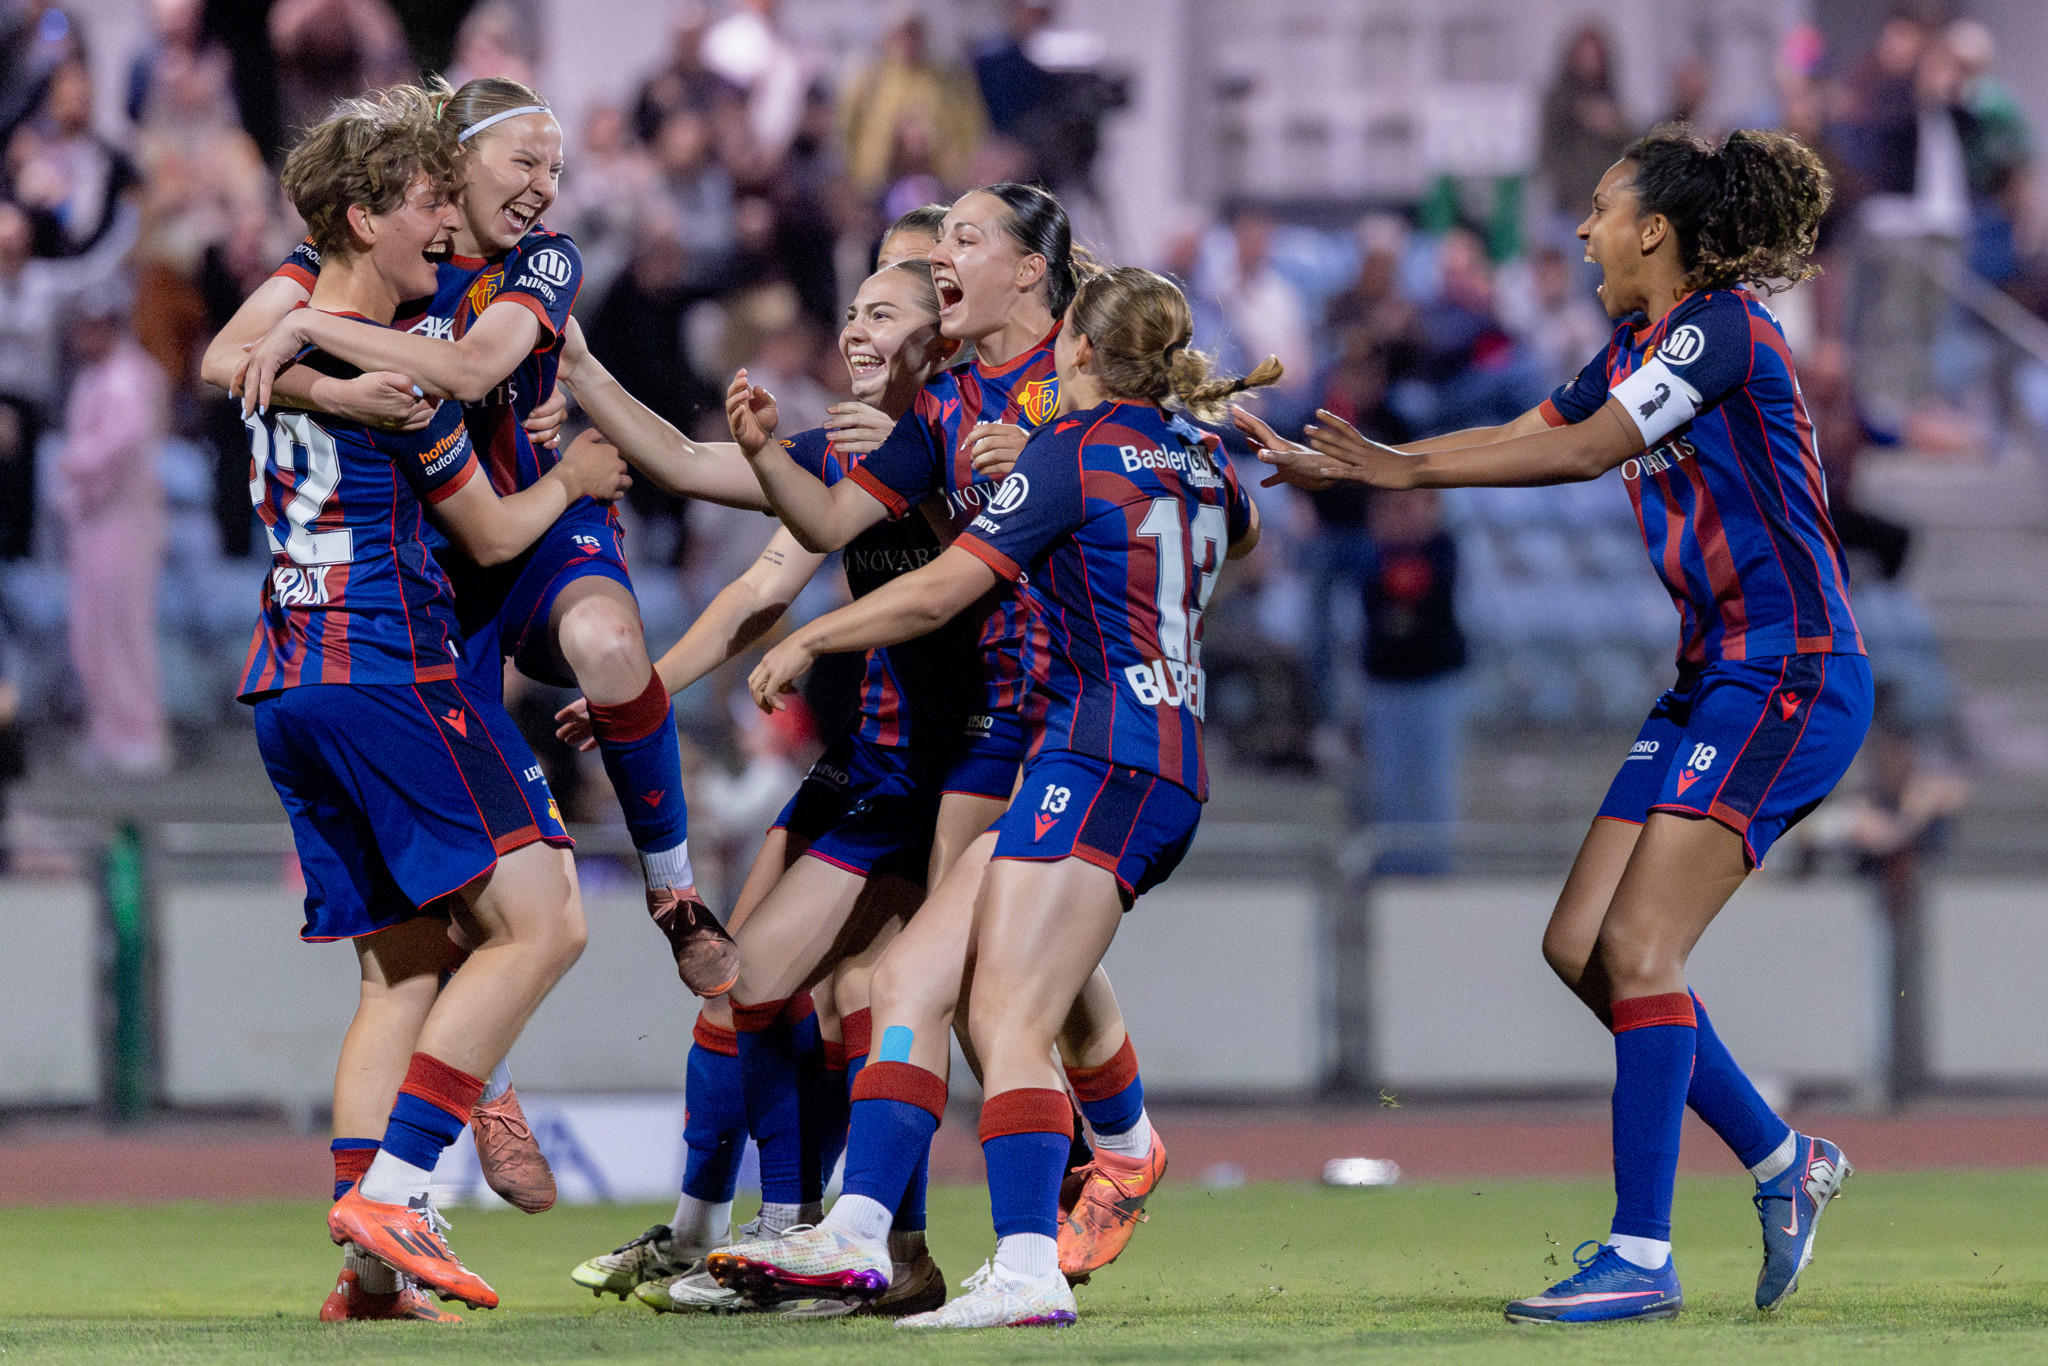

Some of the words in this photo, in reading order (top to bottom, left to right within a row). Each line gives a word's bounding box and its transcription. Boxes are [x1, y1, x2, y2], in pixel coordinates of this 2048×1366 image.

[1119, 443, 1187, 472] Basler
[1621, 435, 1695, 480] OVARTIS
[1687, 742, 1717, 771] 18
[1040, 784, 1071, 813] 13
